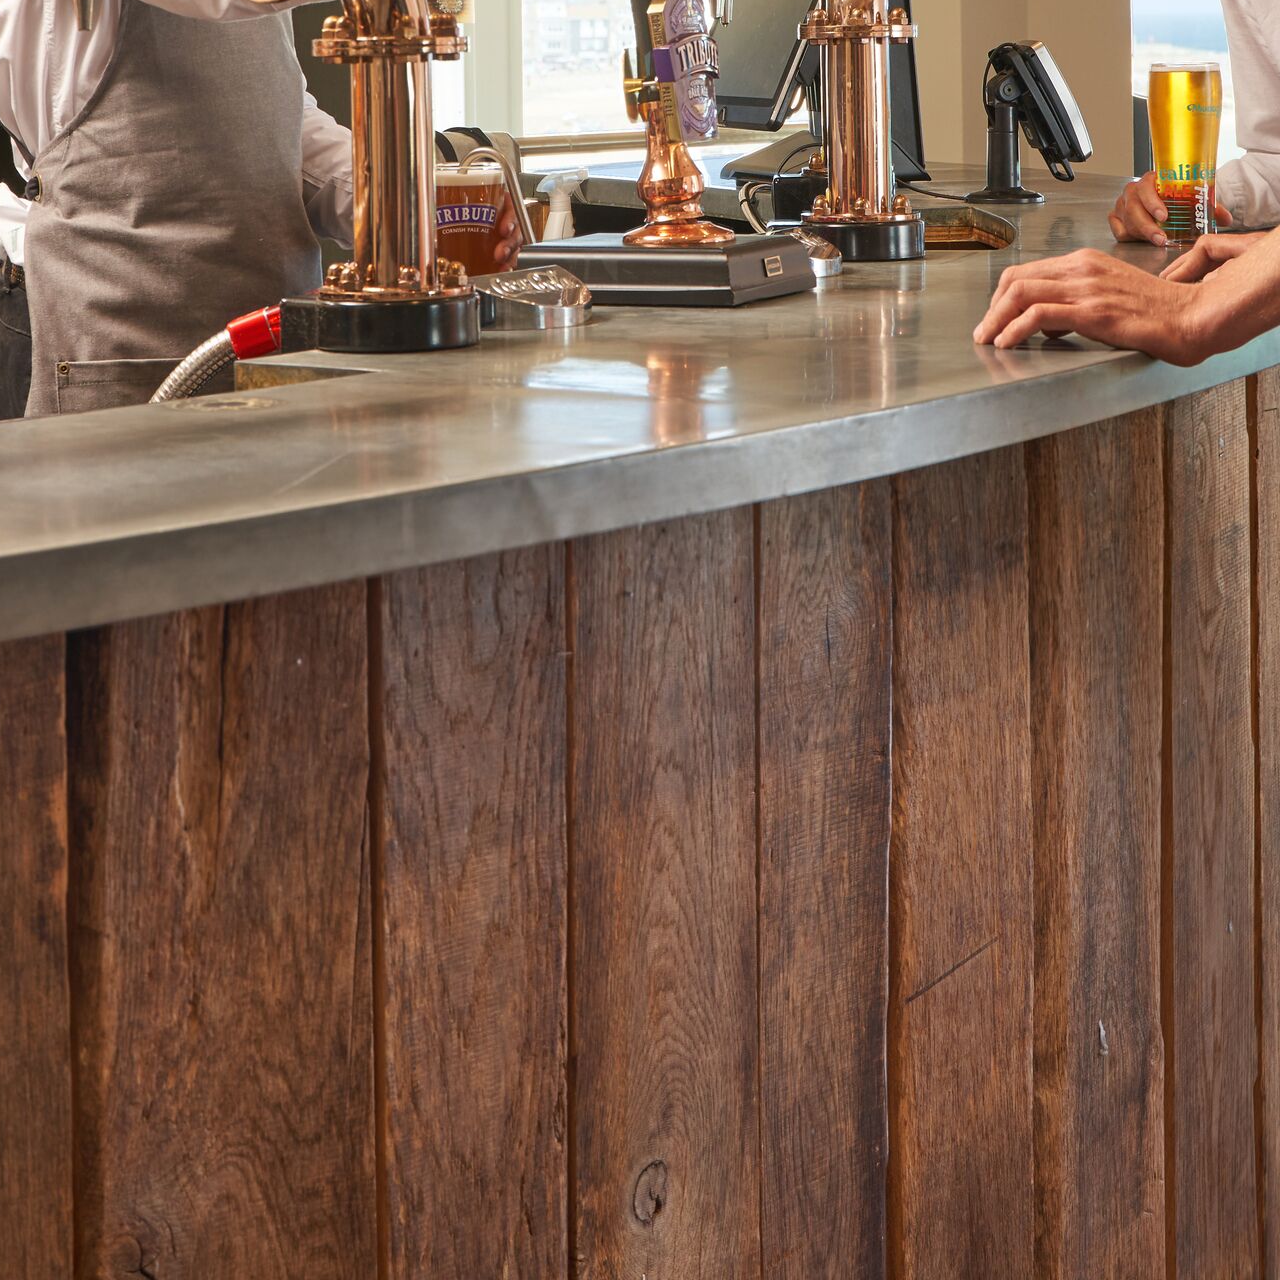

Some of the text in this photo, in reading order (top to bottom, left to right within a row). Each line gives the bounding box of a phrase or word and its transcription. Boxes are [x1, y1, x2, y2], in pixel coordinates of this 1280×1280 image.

[677, 39, 720, 72] TRIBUTE
[436, 207, 496, 224] TRIBUTE
[442, 227, 466, 235] CORNISH
